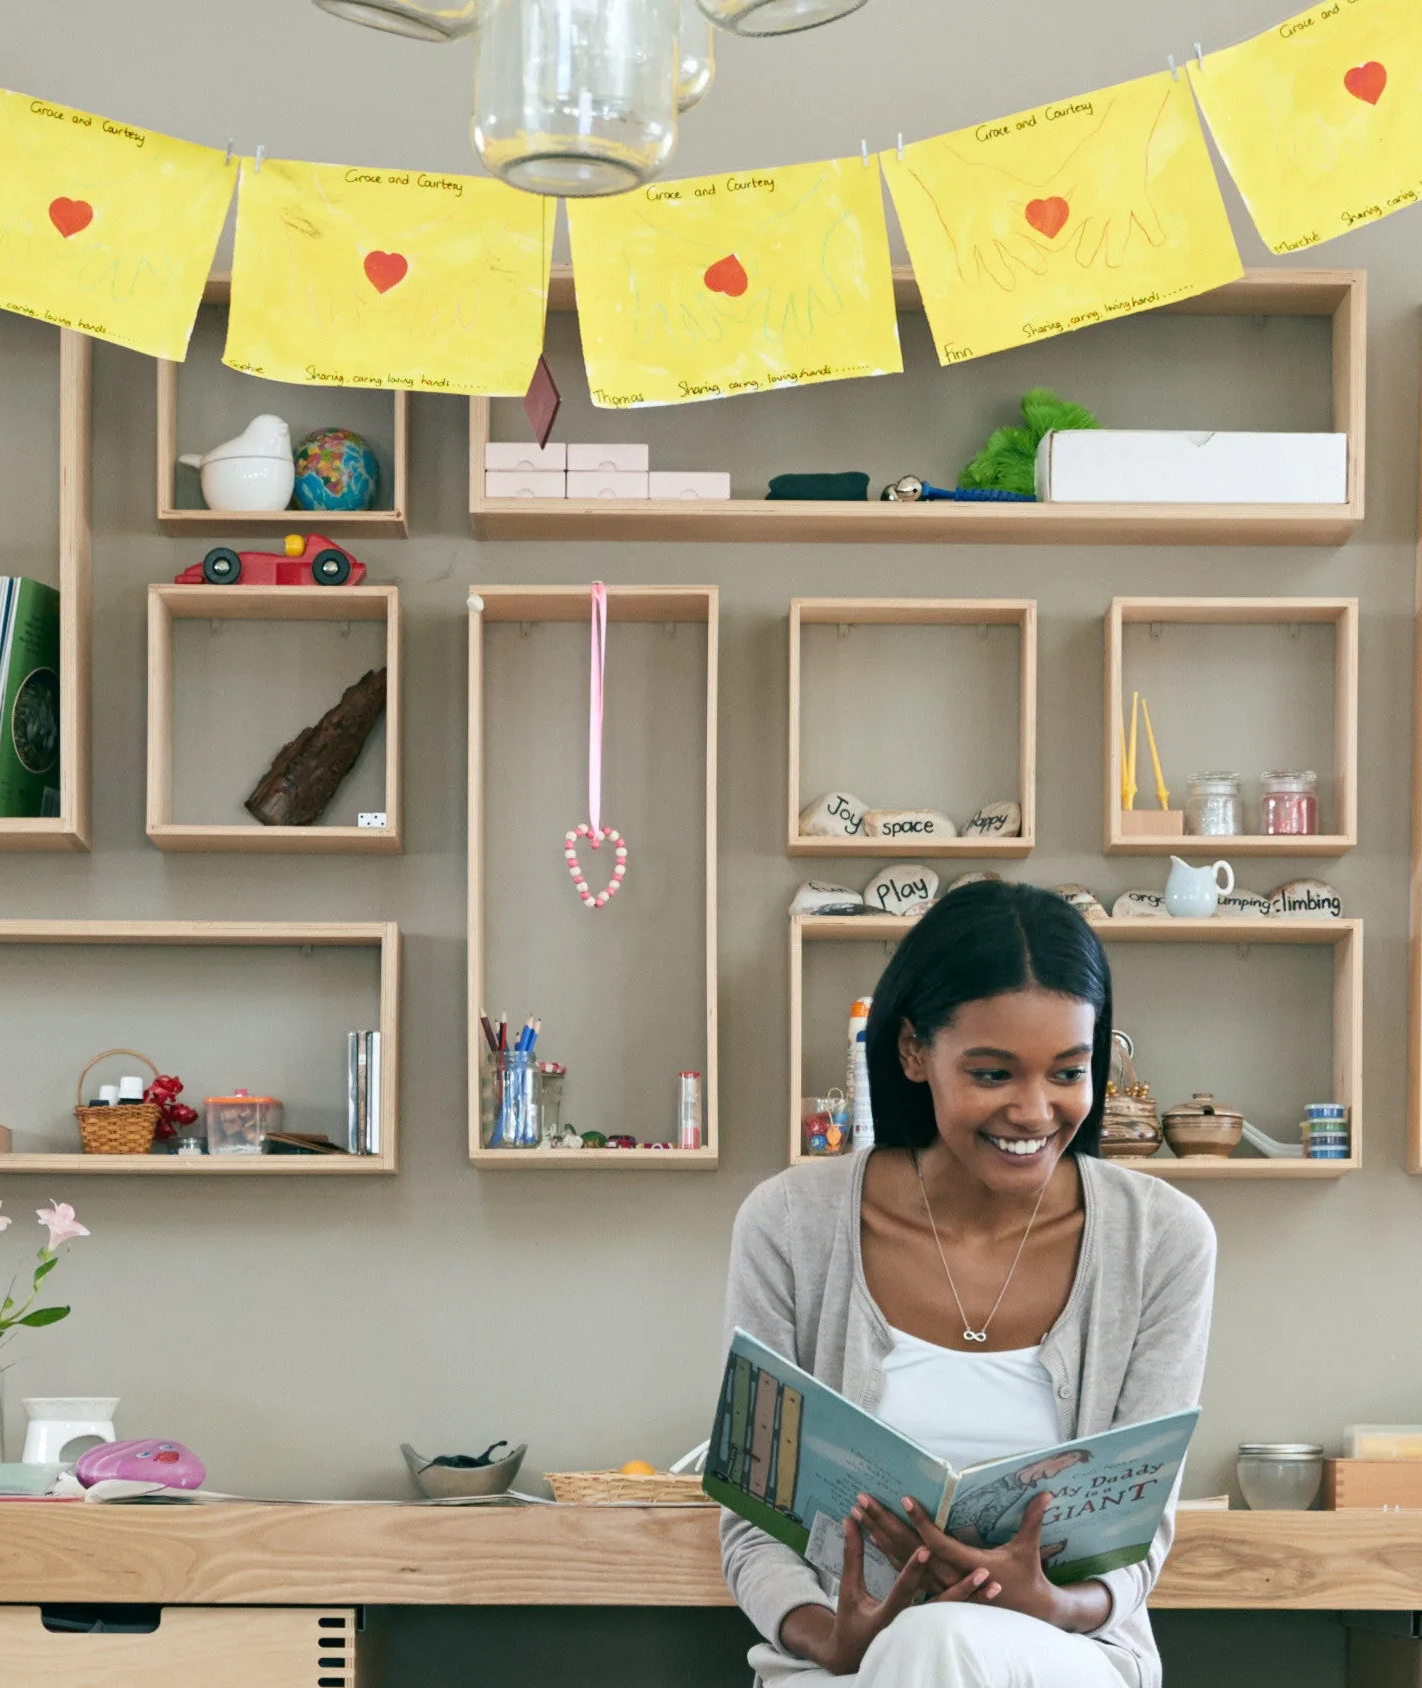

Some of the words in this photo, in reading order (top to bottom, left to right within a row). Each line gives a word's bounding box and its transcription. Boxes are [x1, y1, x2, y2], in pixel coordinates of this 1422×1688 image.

[1280, 17, 1315, 38] Grace
[1321, 4, 1340, 19] and
[30, 101, 64, 120] Grace
[72, 115, 91, 127] and
[102, 120, 146, 147] Courtesy
[975, 123, 1010, 143] Grace
[1016, 115, 1037, 130] and
[1045, 101, 1094, 124] Courtesy
[344, 169, 383, 184] Grace
[389, 174, 409, 185] and
[417, 174, 464, 197] Courtesy
[646, 185, 682, 202] Grace
[694, 184, 716, 197] and
[726, 177, 776, 194] Courtesy
[944, 341, 973, 363] Finn
[592, 389, 644, 406] Thomas
[828, 796, 863, 835] Joy
[882, 819, 934, 837] space
[877, 878, 928, 908] Play
[1217, 896, 1271, 915] umping
[1274, 889, 1341, 916] climbing
[1049, 1485, 1083, 1499] My
[1091, 1462, 1164, 1488] Daddy
[1042, 1479, 1158, 1526] GIANT
